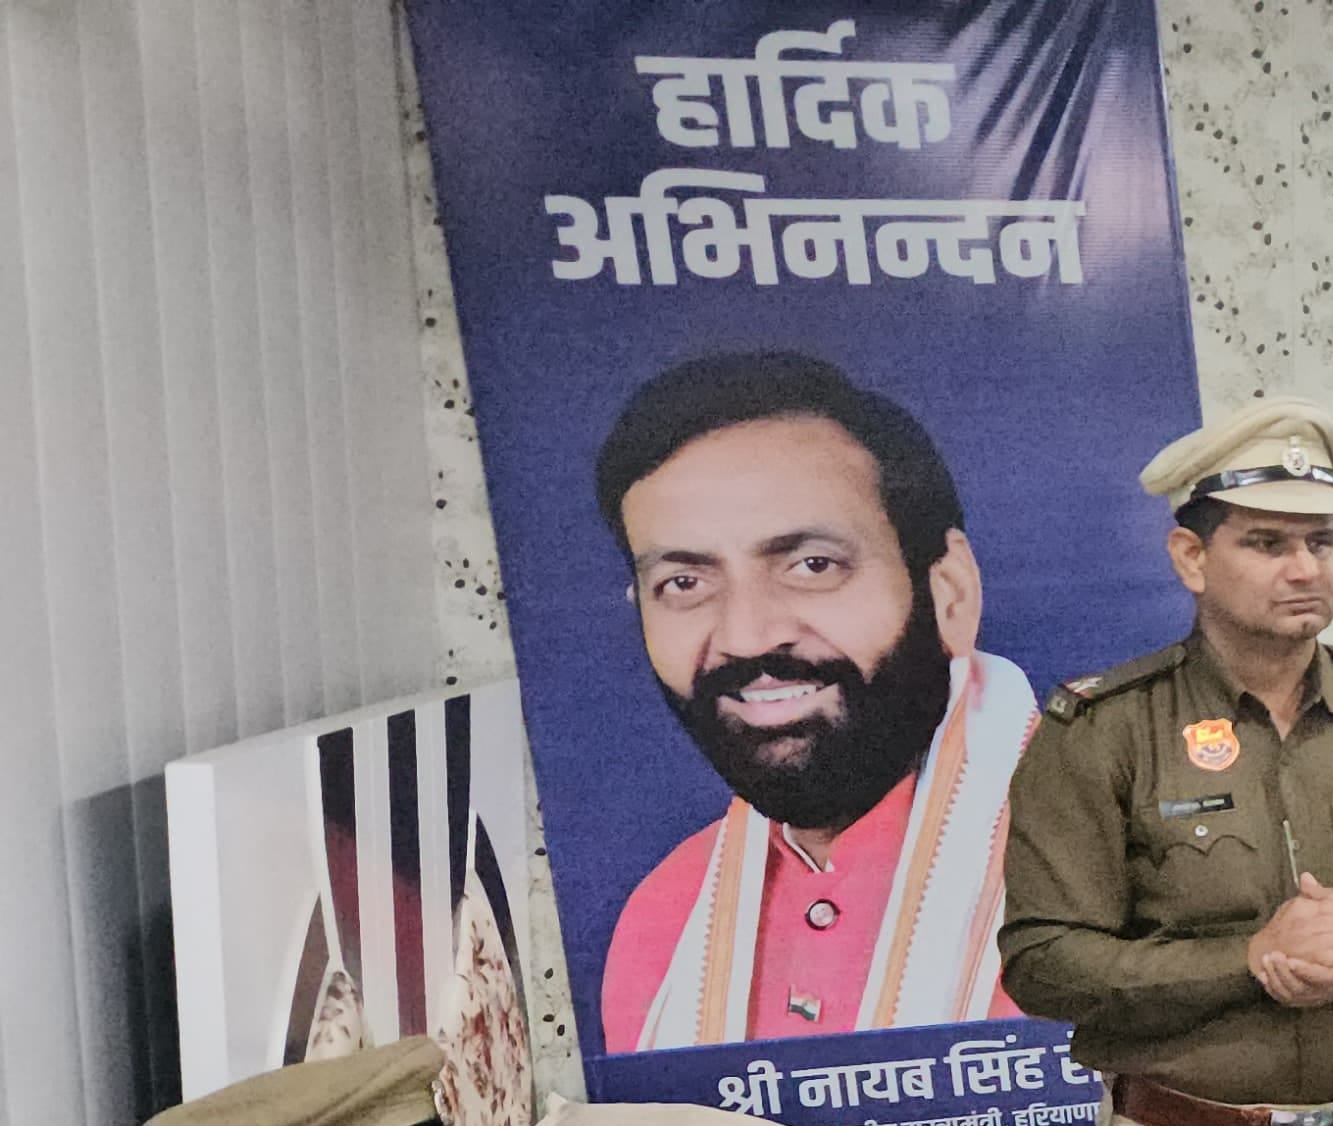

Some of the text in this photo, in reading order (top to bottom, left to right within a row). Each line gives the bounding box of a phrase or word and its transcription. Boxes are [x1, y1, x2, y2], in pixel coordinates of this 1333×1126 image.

[634, 19, 956, 150] हार्दिक
[544, 167, 1086, 286] अभिनन्दन
[718, 1060, 784, 1116] श्री
[790, 1058, 937, 1109] नायब
[943, 1034, 1047, 1097] सिंह
